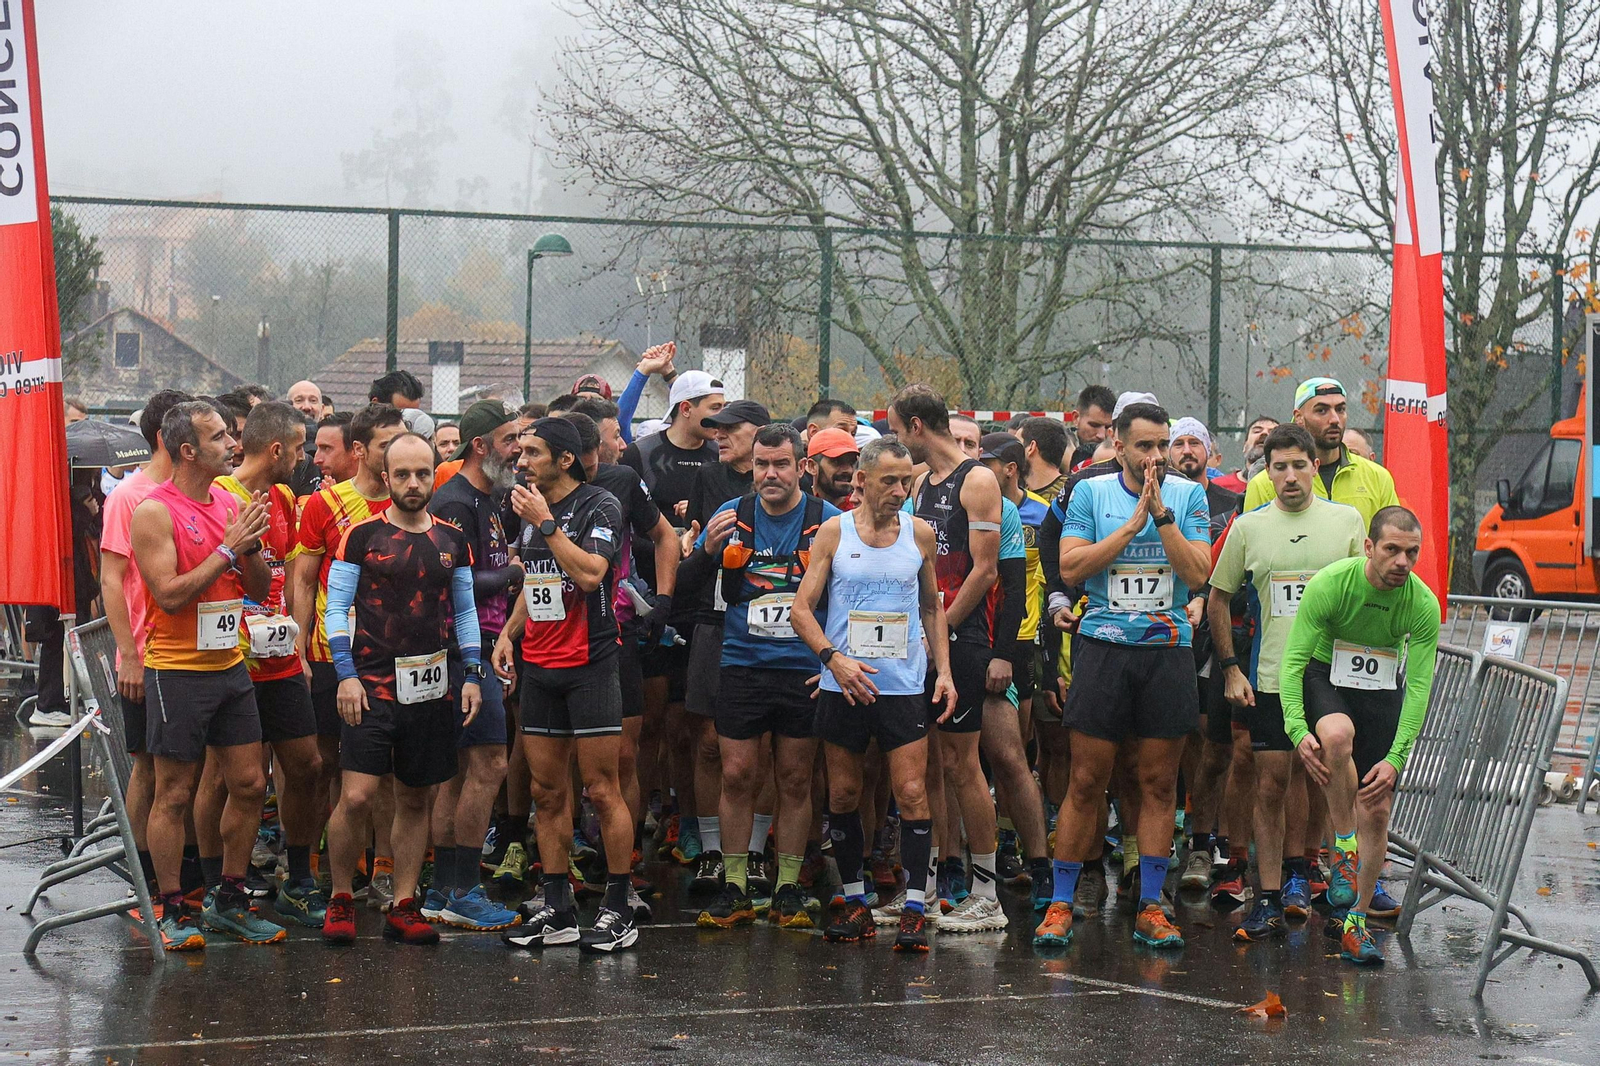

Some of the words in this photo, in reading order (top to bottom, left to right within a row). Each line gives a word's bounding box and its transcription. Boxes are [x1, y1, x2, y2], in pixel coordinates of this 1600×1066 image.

[115, 449, 149, 459] Madeira
[1120, 578, 1160, 595] 117
[532, 587, 552, 605] 58
[217, 614, 236, 632] 49
[267, 625, 287, 642] 79
[874, 625, 884, 642] 1
[1351, 655, 1379, 676] 90
[409, 665, 442, 688] 140
